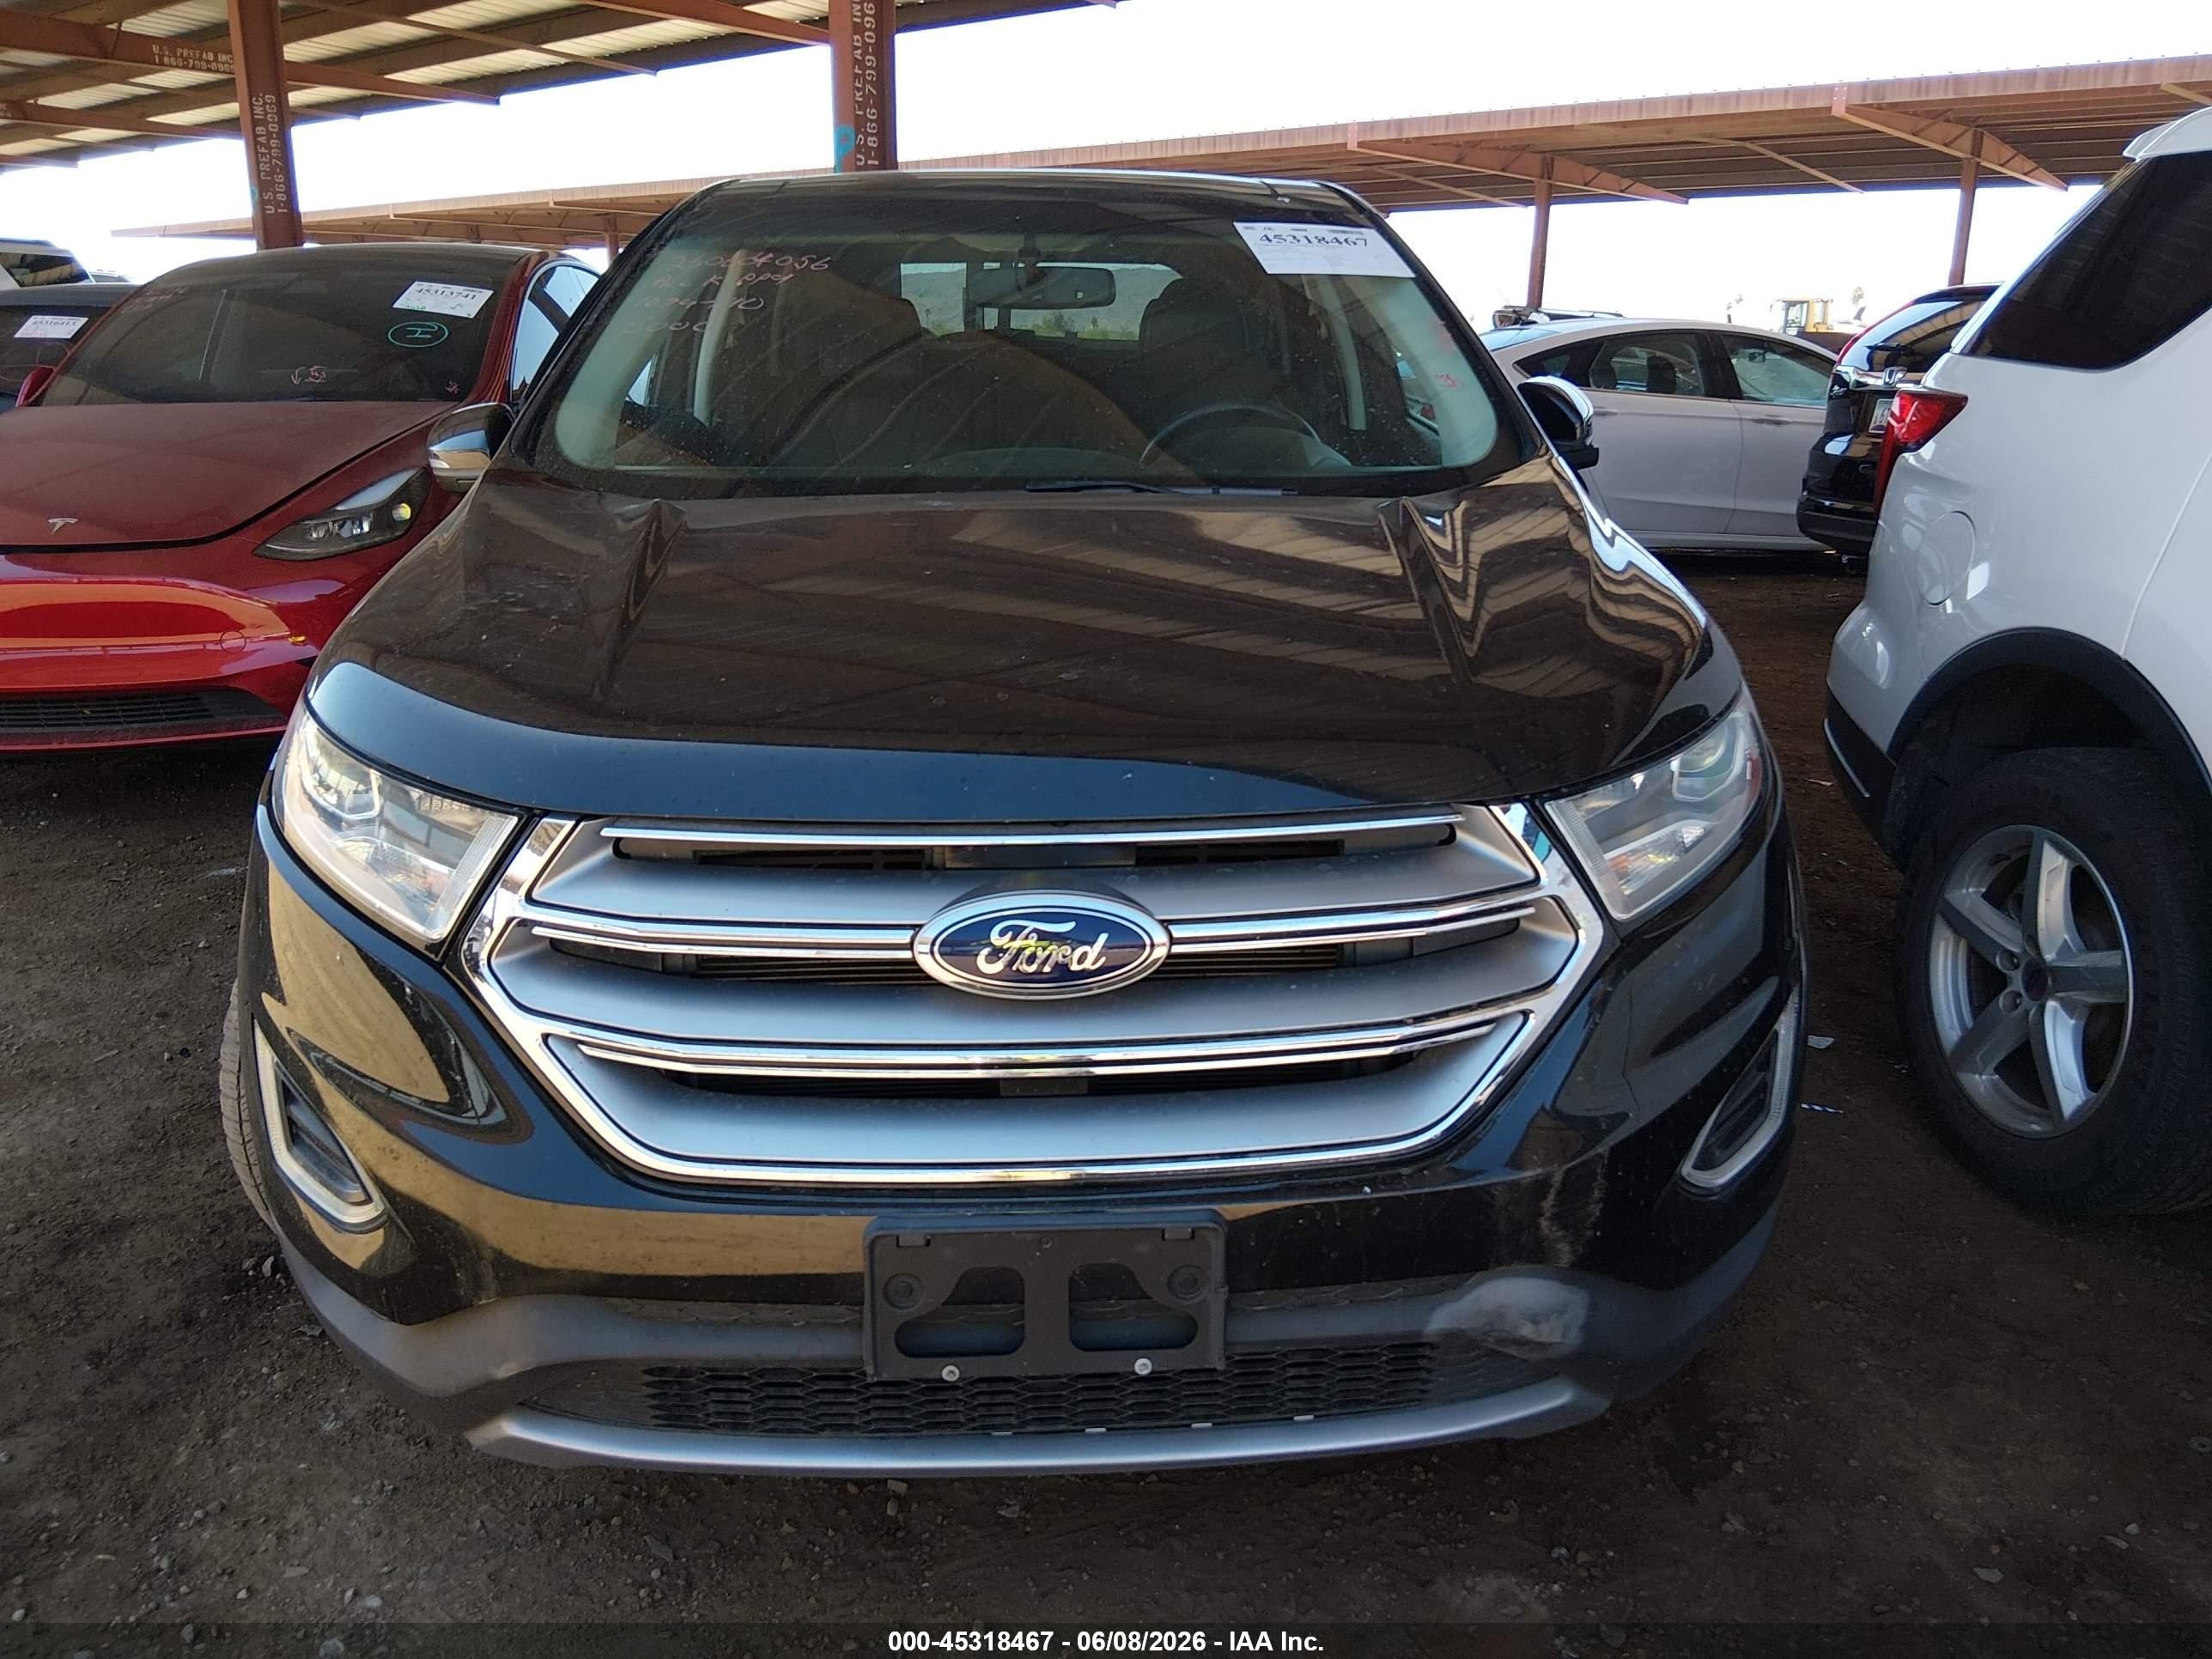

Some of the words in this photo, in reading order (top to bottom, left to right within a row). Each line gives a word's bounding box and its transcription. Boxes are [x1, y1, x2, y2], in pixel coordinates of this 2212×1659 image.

[852, 0, 862, 23] IN
[152, 44, 173, 56] U.S.
[177, 48, 214, 61] PREFAB
[853, 34, 865, 115] PREFAB
[252, 93, 265, 119] INC.
[255, 125, 272, 180] PREFAB
[265, 94, 288, 214] 1-866-799-0969
[856, 128, 866, 167] U.S.
[262, 187, 275, 214] U.S.
[1258, 234, 1368, 248] 45318467
[975, 919, 1109, 975] Ford
